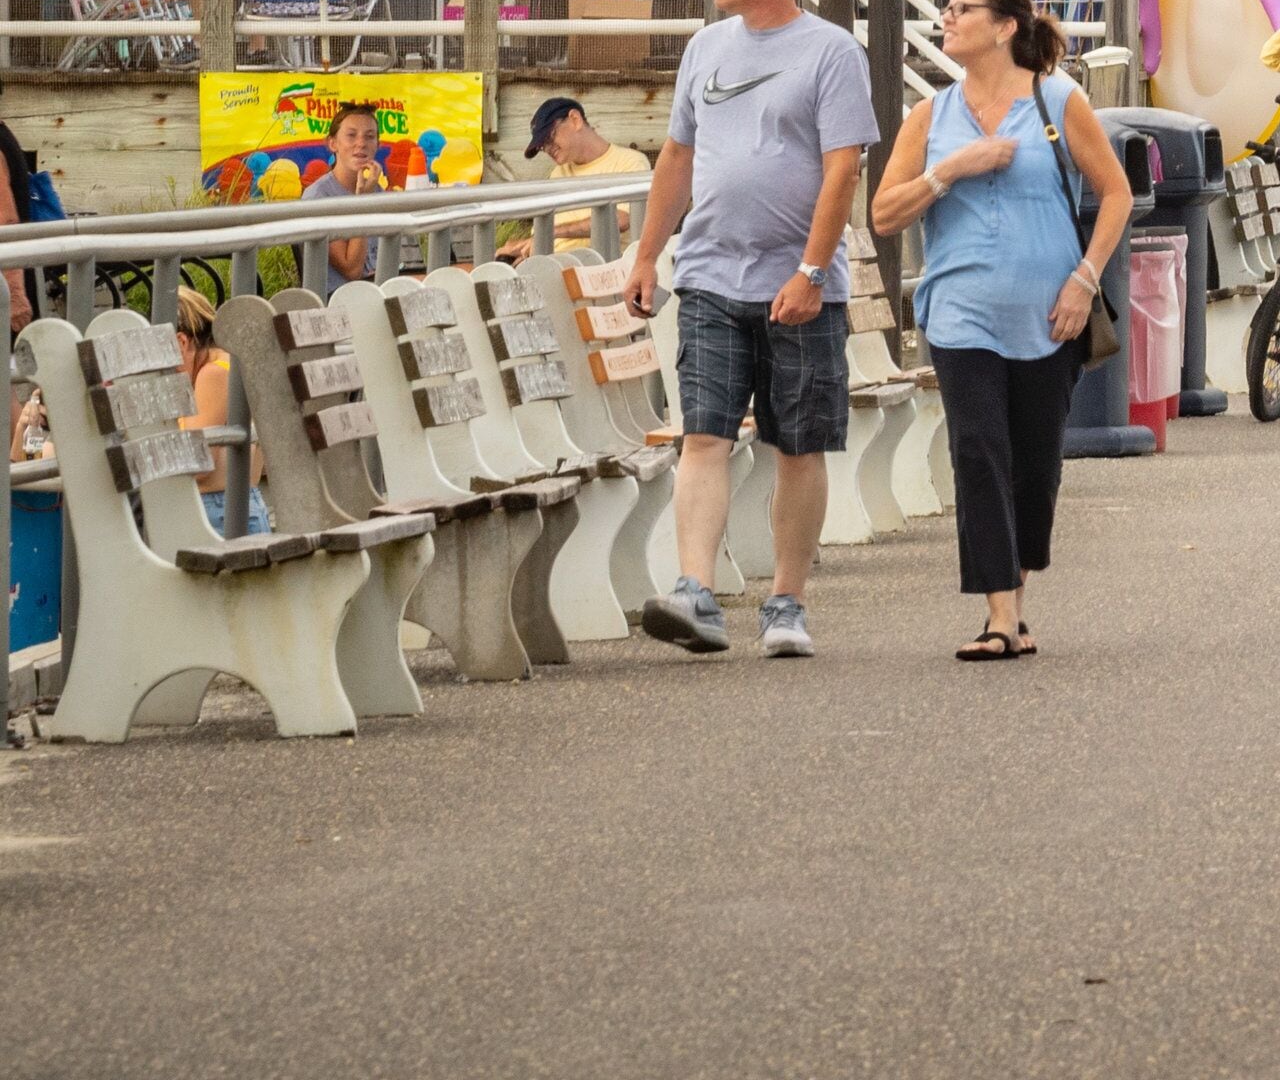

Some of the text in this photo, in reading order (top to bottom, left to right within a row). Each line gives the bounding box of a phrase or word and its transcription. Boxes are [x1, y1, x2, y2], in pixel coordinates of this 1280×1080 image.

[219, 84, 260, 100] Proudly
[223, 95, 260, 111] Serving
[376, 110, 409, 134] ICE
